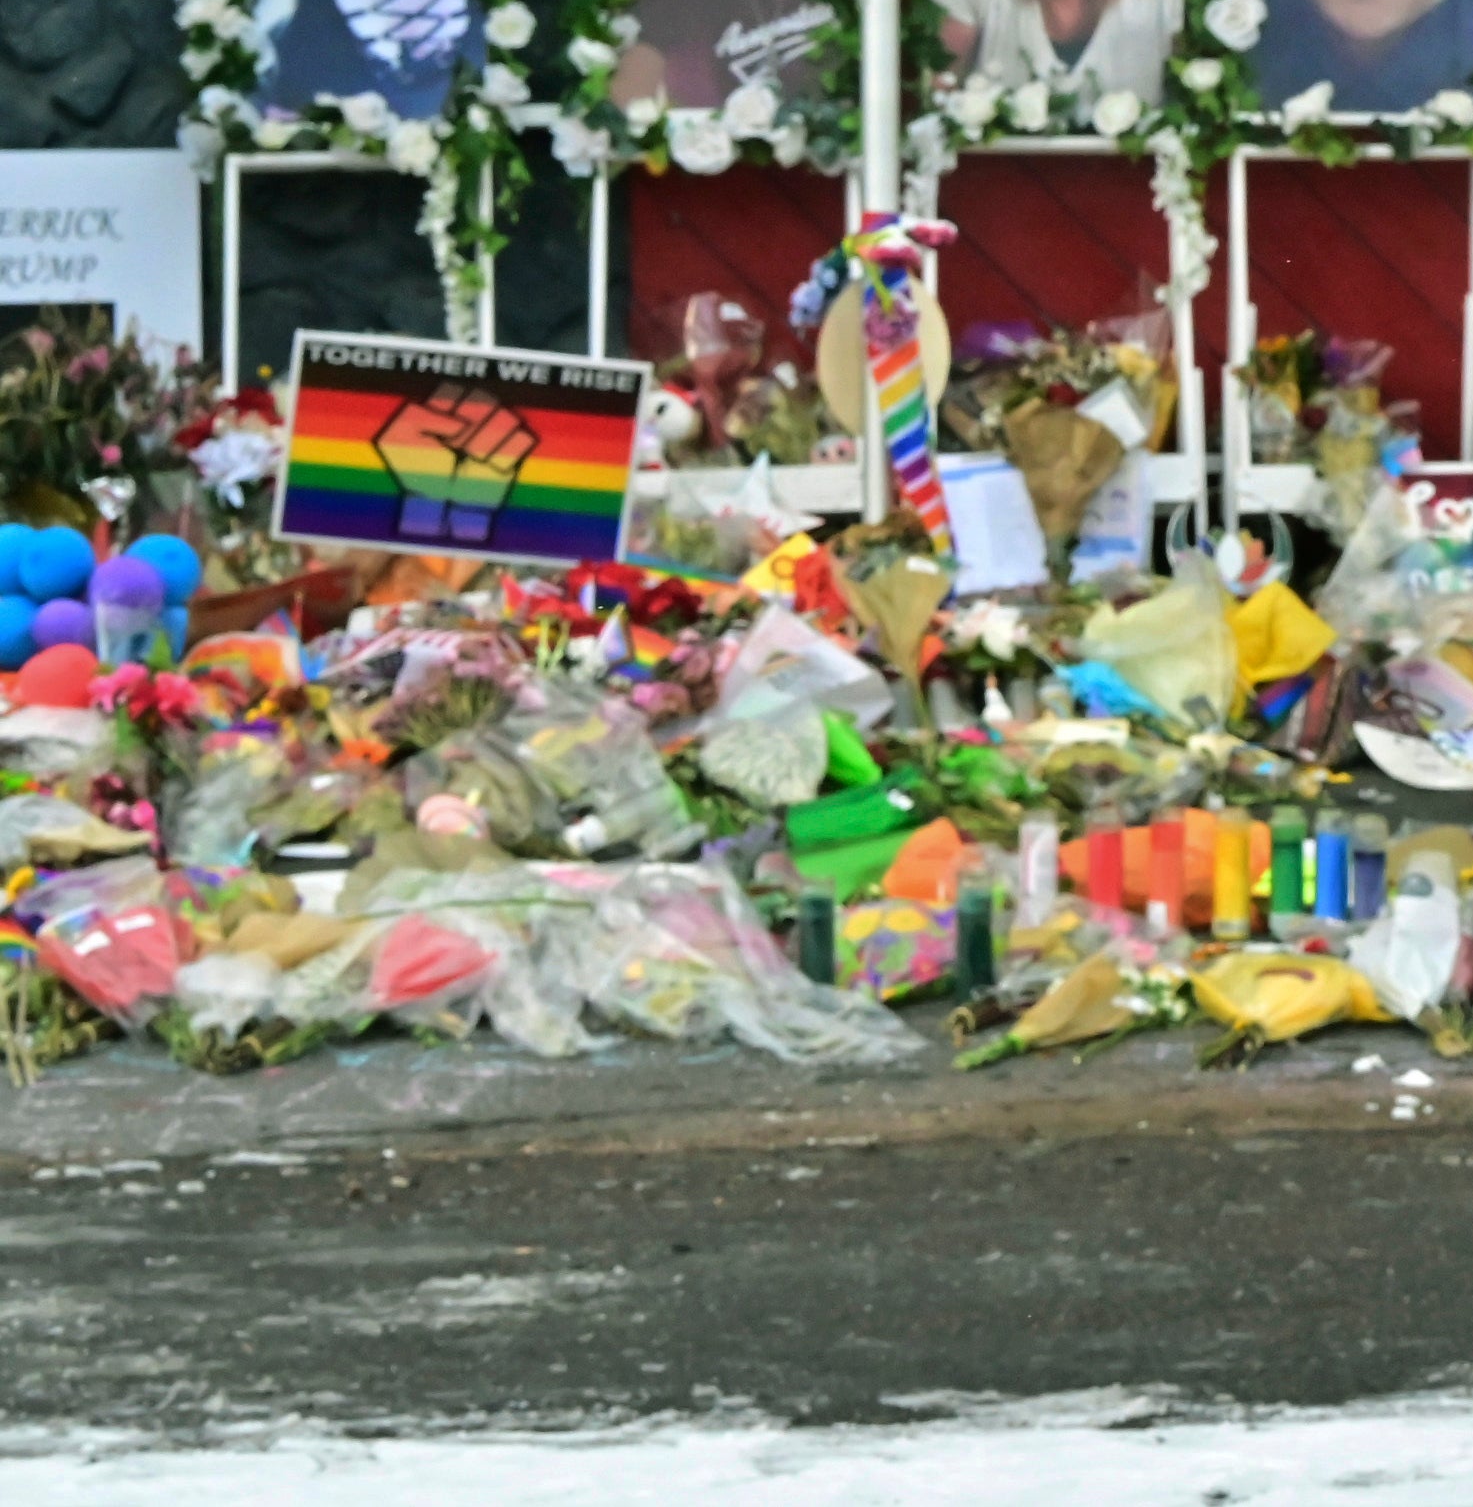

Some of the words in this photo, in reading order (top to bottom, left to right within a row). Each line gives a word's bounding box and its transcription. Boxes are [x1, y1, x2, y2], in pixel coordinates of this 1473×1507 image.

[307, 343, 488, 378] TOGETHER
[498, 359, 551, 387] WE
[559, 366, 641, 392] RISE
